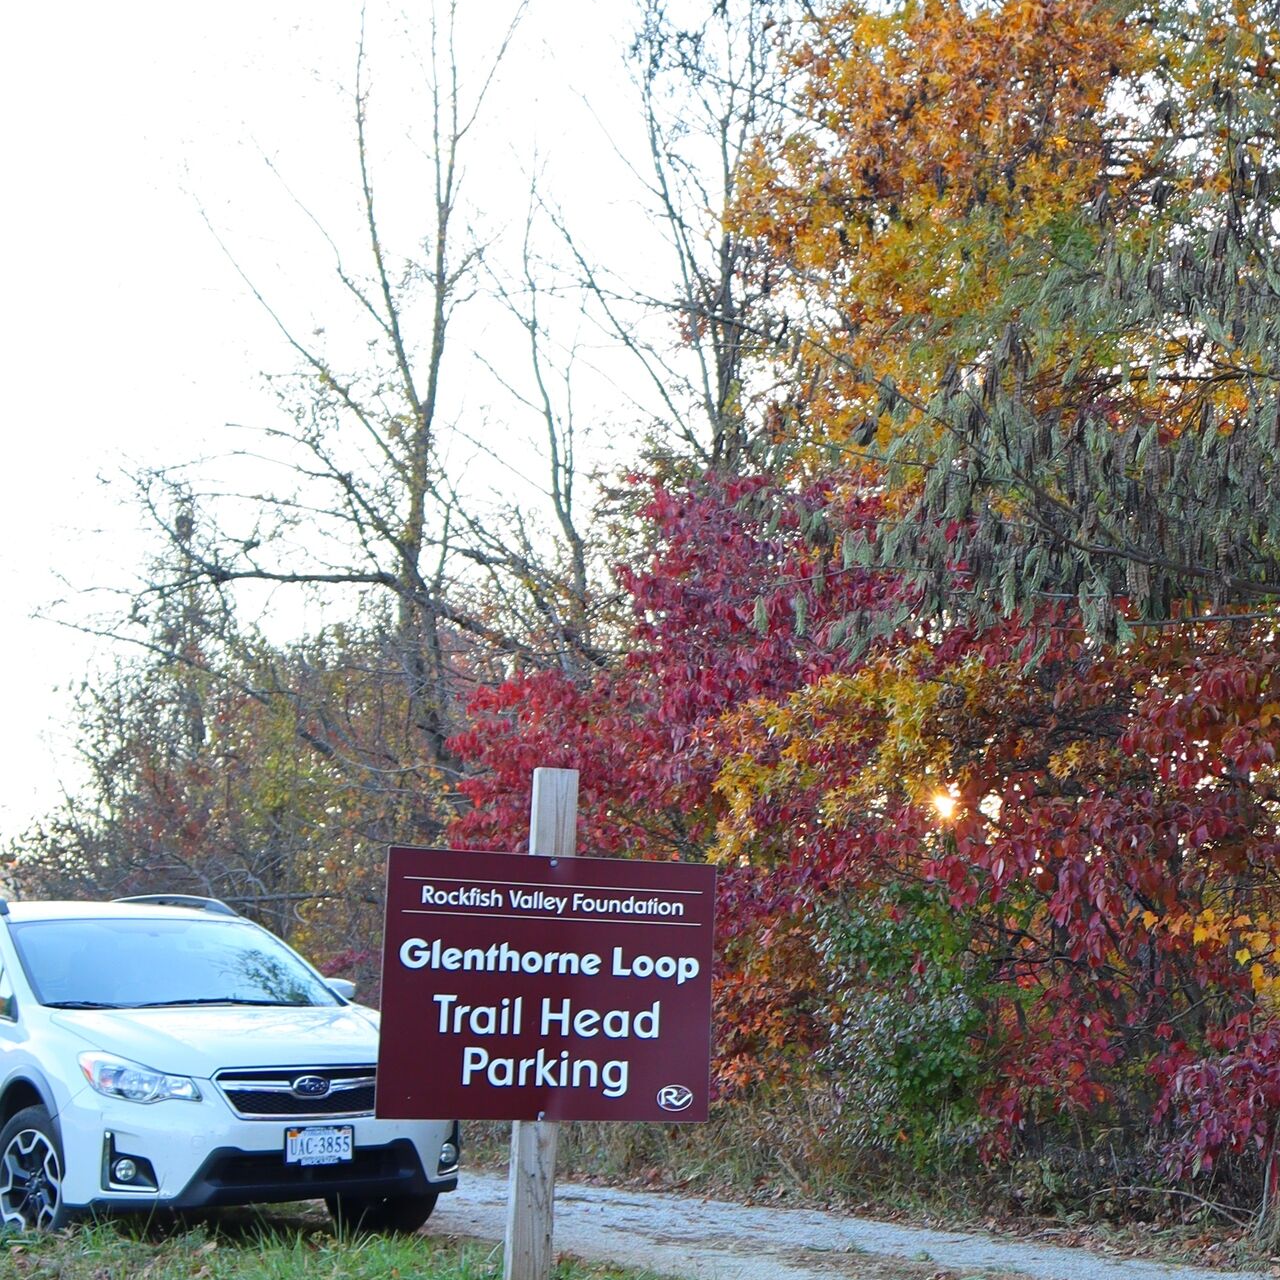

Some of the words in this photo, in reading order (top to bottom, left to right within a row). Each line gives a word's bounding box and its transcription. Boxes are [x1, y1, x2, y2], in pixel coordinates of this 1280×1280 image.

[422, 885, 503, 908] Rockfish
[509, 889, 568, 915] Valley
[572, 893, 684, 916] Foundation
[400, 937, 602, 976] Glenthorne
[612, 946, 701, 985] Loop
[433, 994, 523, 1035] Trail
[540, 997, 661, 1039] Head
[461, 1046, 630, 1098] Parking
[290, 1136, 350, 1156] UAC-3855
